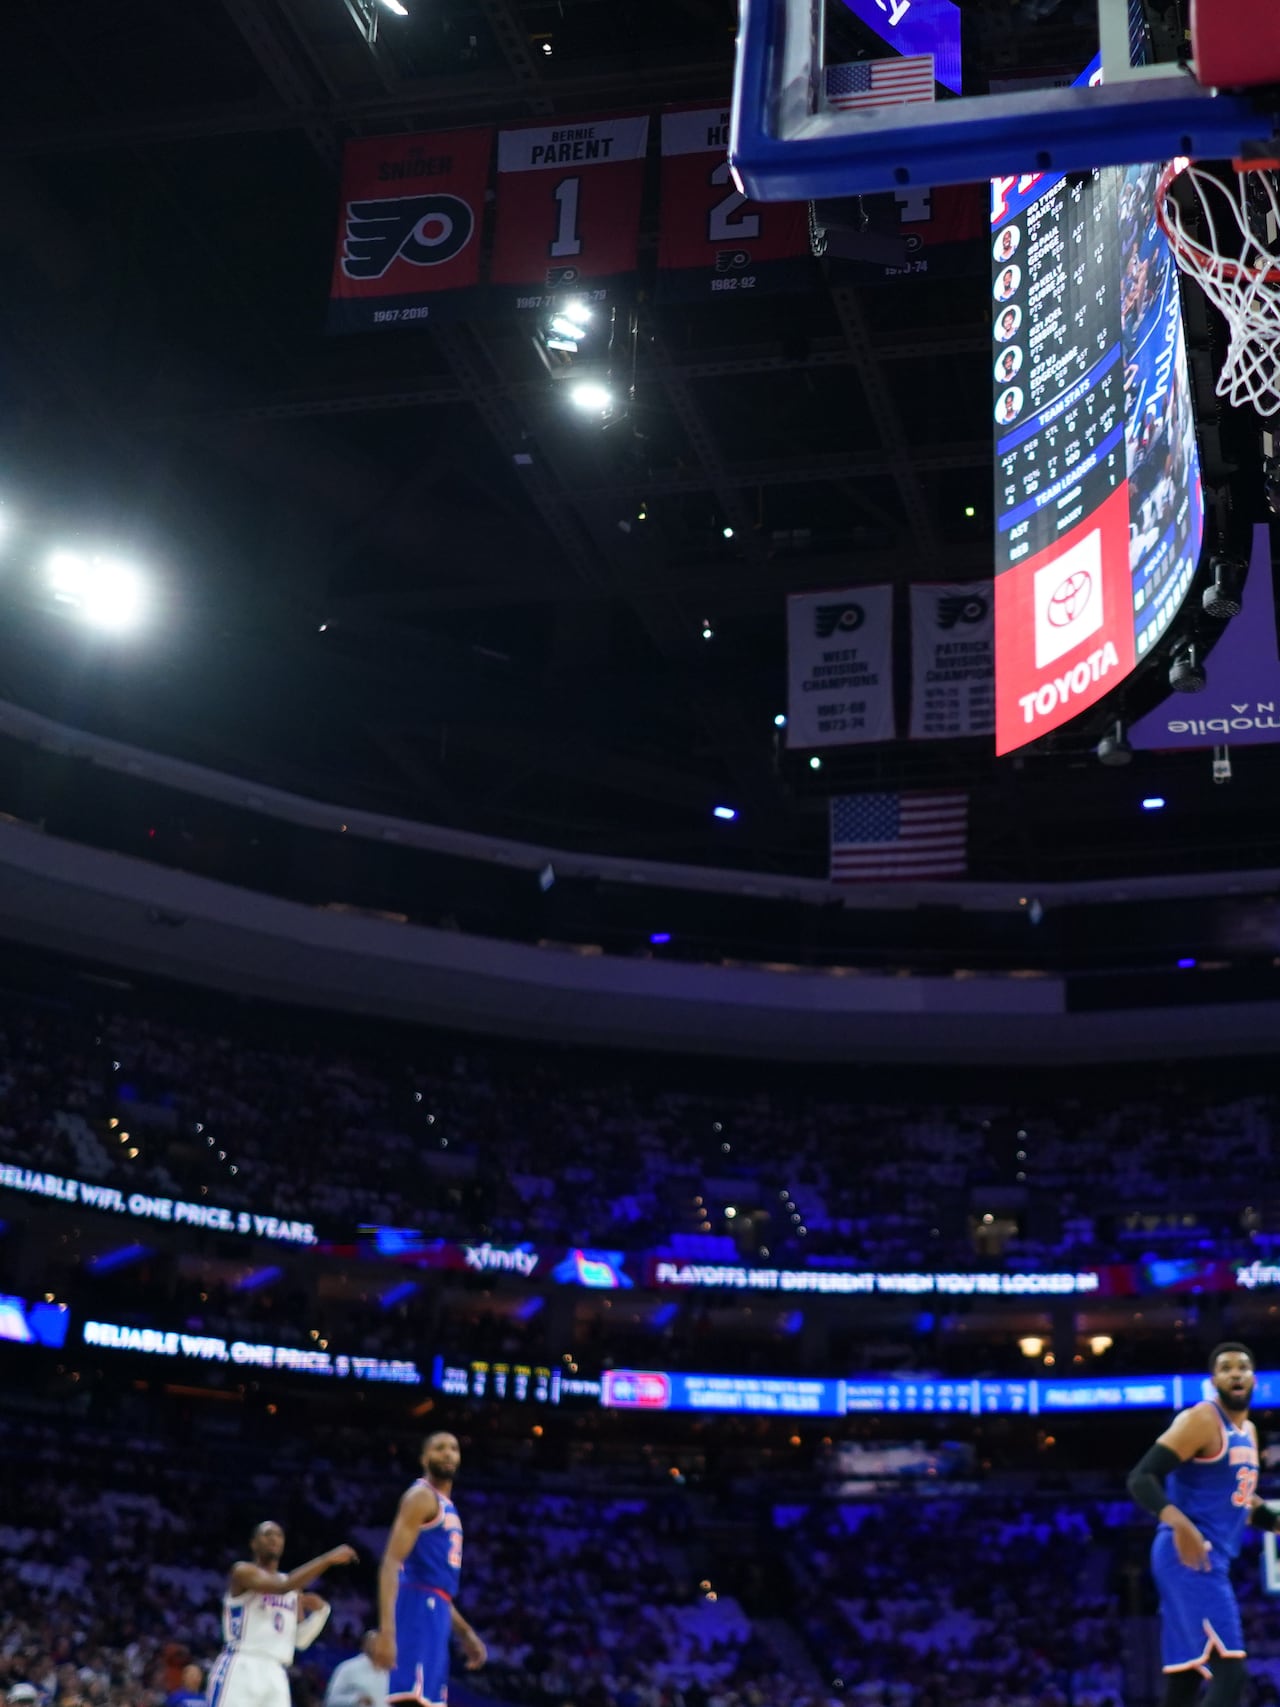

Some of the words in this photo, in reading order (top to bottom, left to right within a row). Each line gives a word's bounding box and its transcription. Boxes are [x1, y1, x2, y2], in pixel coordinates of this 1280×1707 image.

[552, 127, 595, 141] BERNIE
[531, 138, 614, 165] PARENT
[551, 176, 580, 256] 1
[374, 307, 429, 322] 1967-2016
[1038, 401, 1064, 426] TEAM
[1064, 379, 1090, 406] STATS
[1035, 482, 1062, 507] TEAM
[823, 649, 857, 663] WEST
[935, 641, 990, 655] PATRICK
[812, 662, 868, 677] DIVISION
[926, 668, 994, 682] CHAMPION
[1019, 641, 1119, 723] TOYOTA
[802, 674, 879, 692] CHAMPIONS
[127, 1193, 173, 1220] ONE
[465, 1243, 538, 1275] xfinity
[655, 1262, 747, 1289] PLAYOFFS
[750, 1270, 779, 1290] HIT
[780, 1271, 875, 1294] DIFFERENT
[877, 1272, 932, 1294] WHEN
[84, 1320, 180, 1355] RELIABLE
[230, 1341, 274, 1368] ONE
